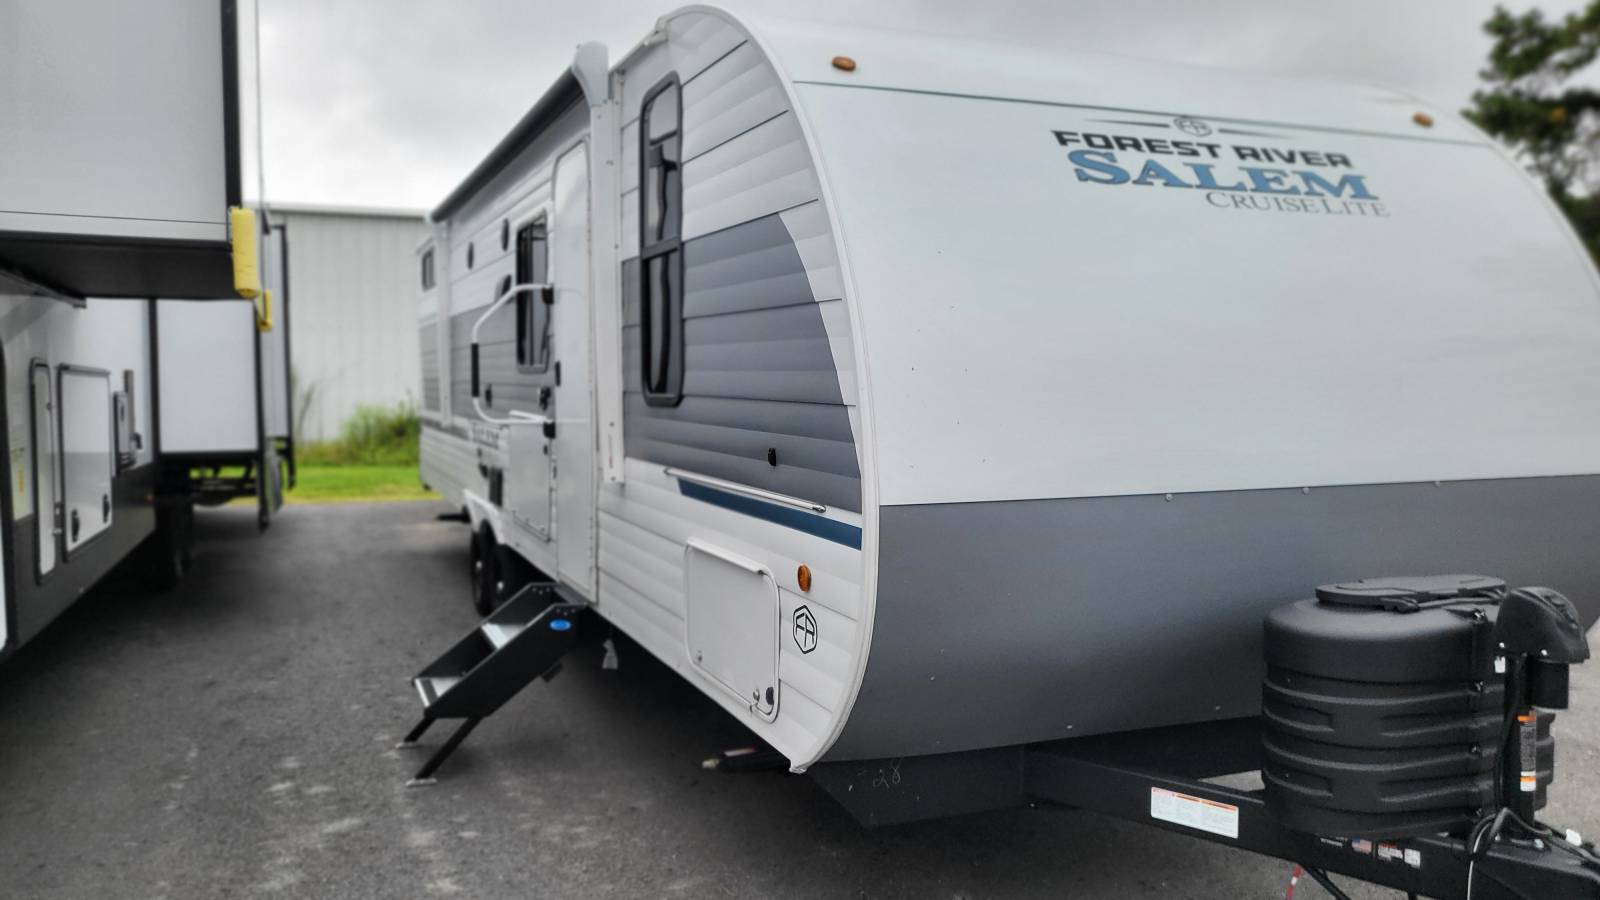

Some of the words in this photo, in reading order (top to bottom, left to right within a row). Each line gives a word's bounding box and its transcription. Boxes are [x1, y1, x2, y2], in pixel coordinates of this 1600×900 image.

[1052, 130, 1221, 158] FOREST
[1230, 145, 1353, 168] RIVER
[1067, 149, 1379, 201] SALEM
